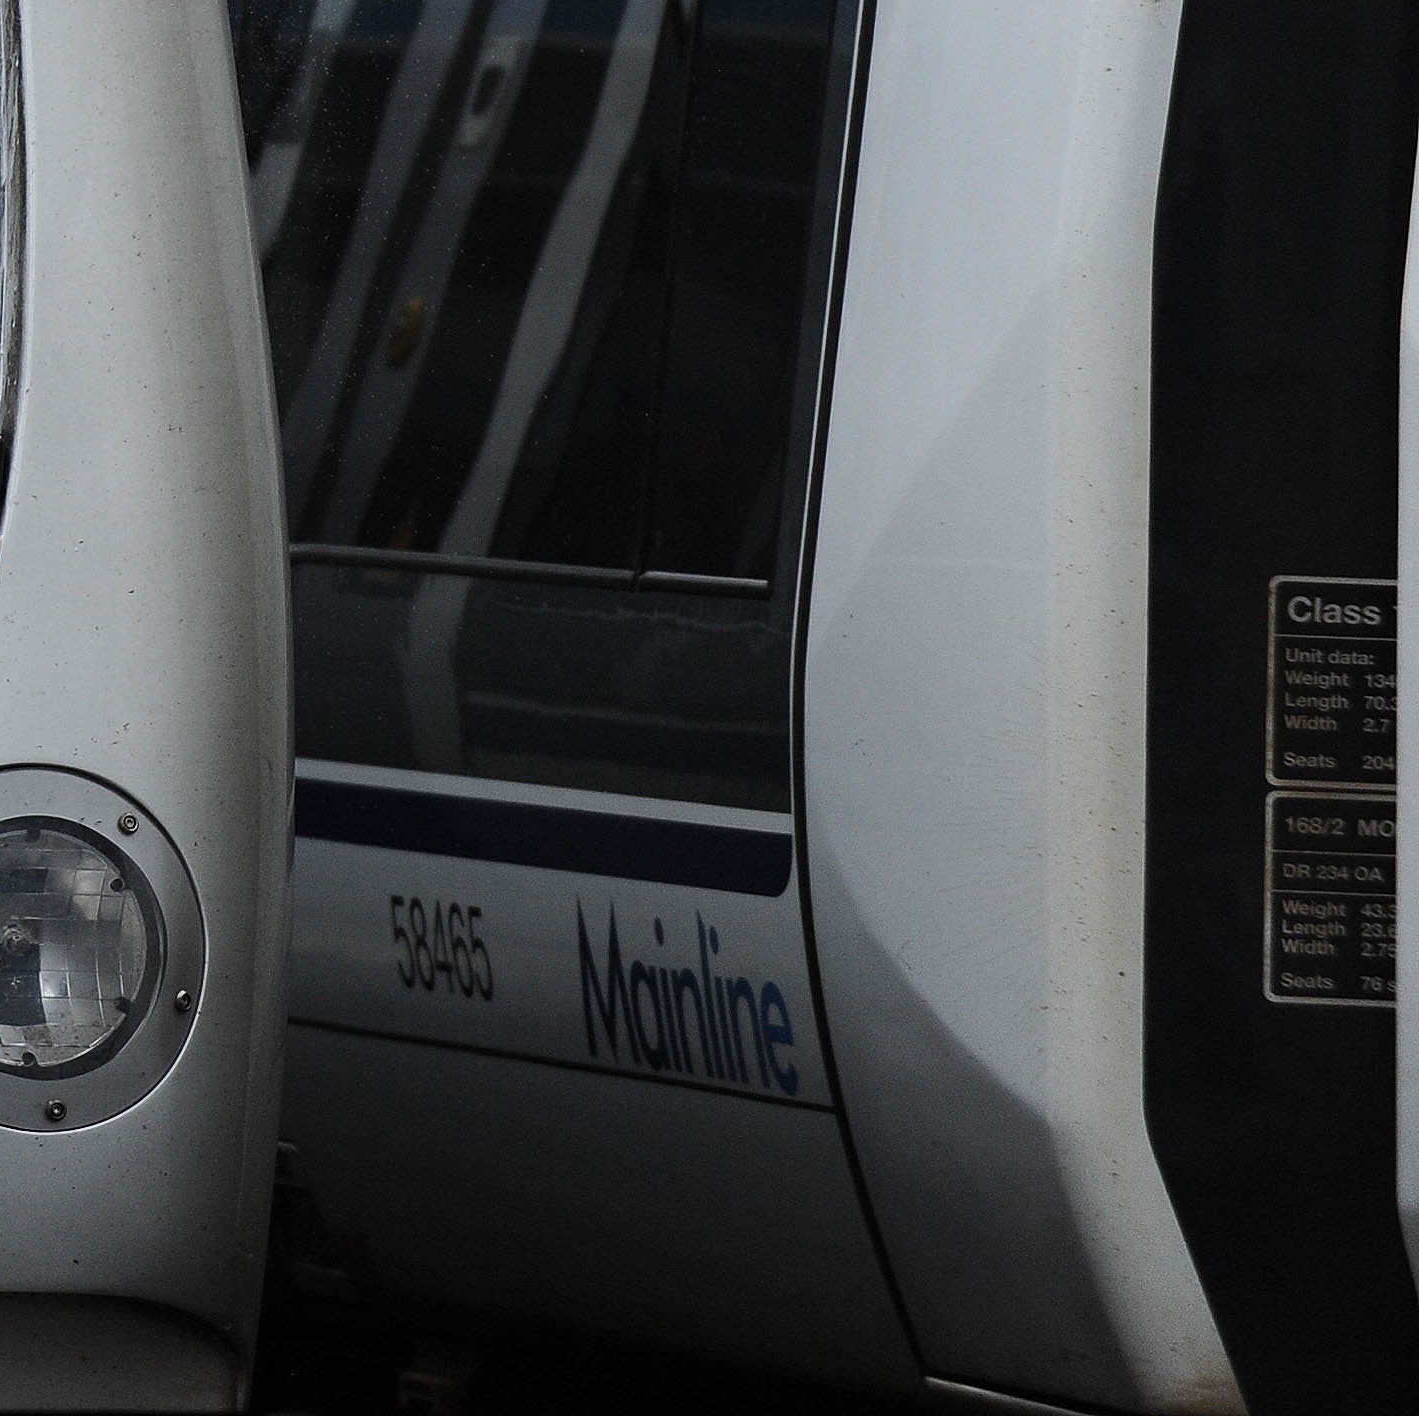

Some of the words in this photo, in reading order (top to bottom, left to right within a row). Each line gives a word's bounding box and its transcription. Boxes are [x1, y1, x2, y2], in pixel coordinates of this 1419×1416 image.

[1286, 595, 1382, 626] Class
[1285, 647, 1324, 664] Unit
[1328, 648, 1376, 666] data:
[1283, 670, 1350, 690] Weight
[1283, 692, 1349, 712] Length
[1283, 715, 1338, 732] Width
[1283, 752, 1338, 769] Seats
[1284, 816, 1346, 836] 168/2
[1282, 863, 1311, 878] DR
[1316, 865, 1349, 880] 234
[1281, 899, 1347, 919] Weight
[1281, 920, 1346, 938] Length
[390, 895, 494, 1001] 58465
[1281, 938, 1336, 955] Width
[1280, 972, 1335, 990] Seats
[576, 894, 799, 1096] Mainline
